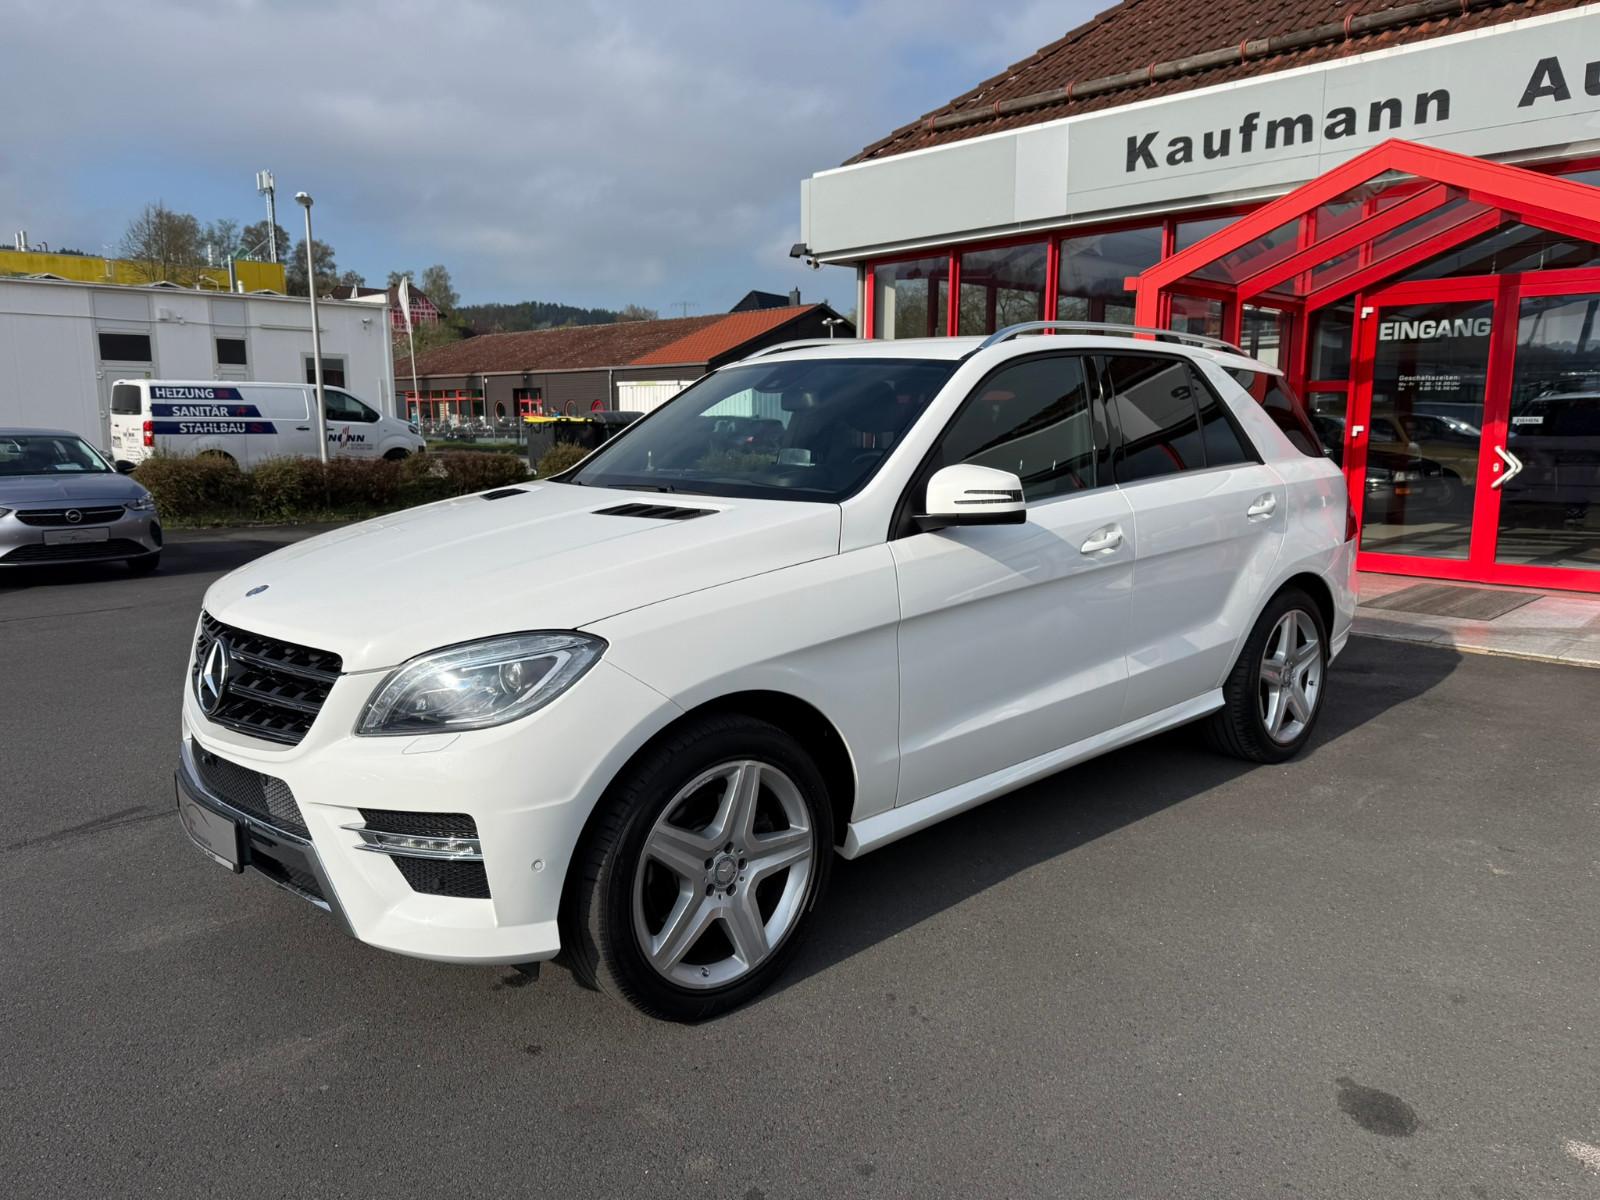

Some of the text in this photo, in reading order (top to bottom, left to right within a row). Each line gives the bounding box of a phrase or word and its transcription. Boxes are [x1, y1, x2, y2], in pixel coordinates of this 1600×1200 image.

[1126, 88, 1451, 172] Kaufmann
[1379, 318, 1491, 340] EINGANG
[155, 387, 215, 398] HEIZUNG
[172, 404, 229, 416] SANITÄR
[179, 423, 246, 433] STAHLBAU
